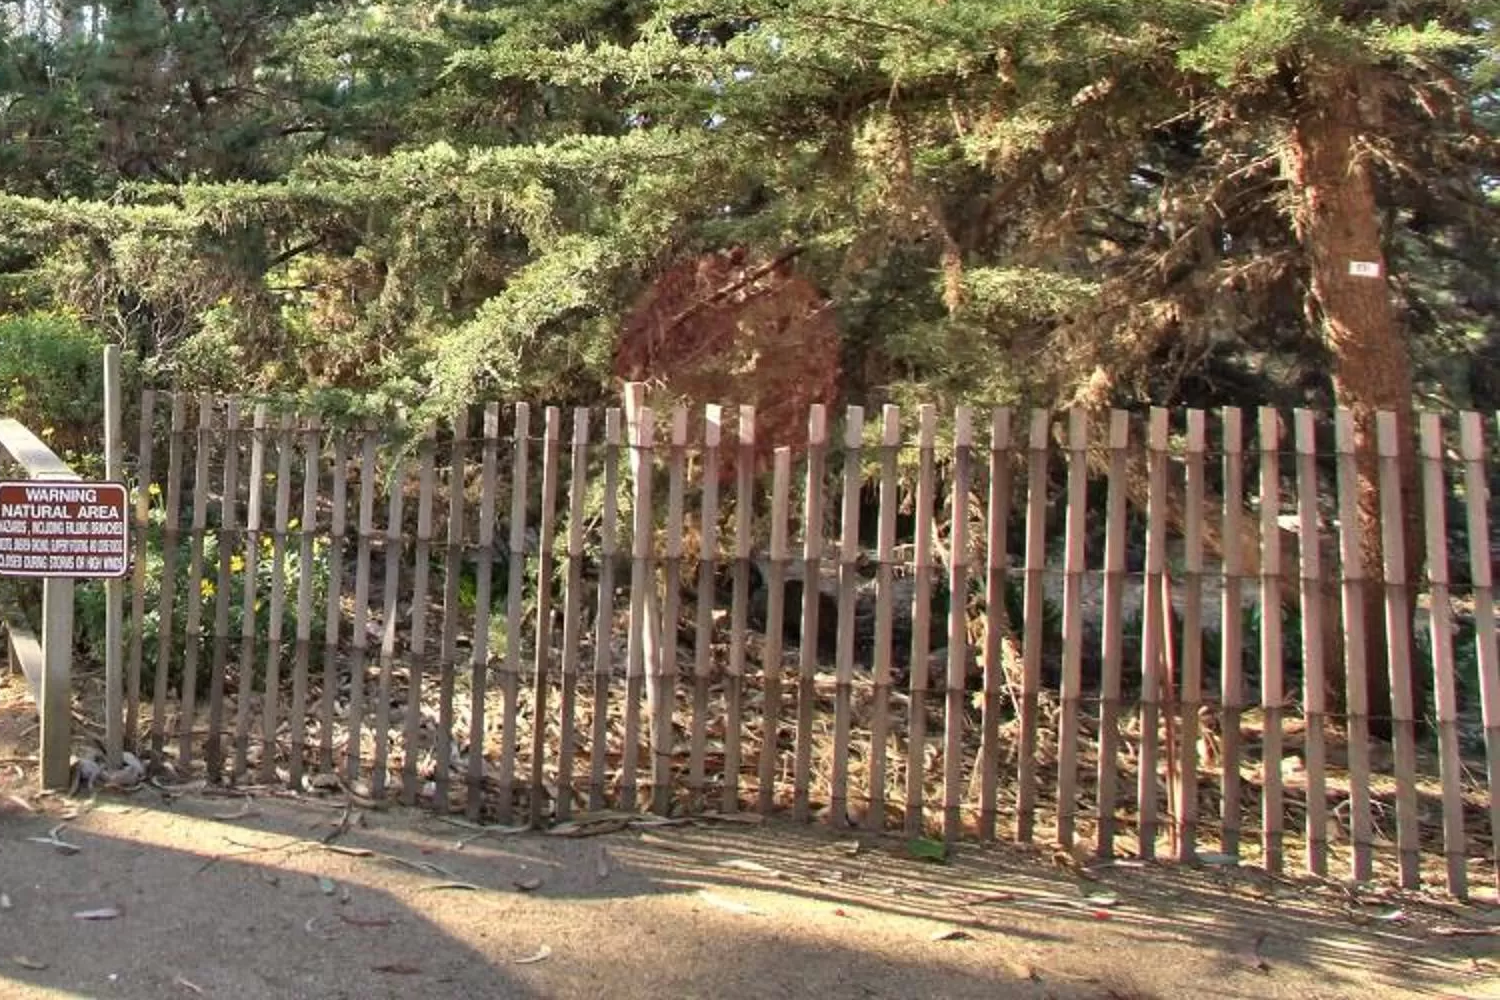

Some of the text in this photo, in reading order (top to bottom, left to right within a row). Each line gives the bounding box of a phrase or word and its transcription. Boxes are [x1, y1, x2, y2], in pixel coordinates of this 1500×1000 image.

[25, 488, 97, 503] WARNING
[1, 504, 119, 519] NATURAL AREA
